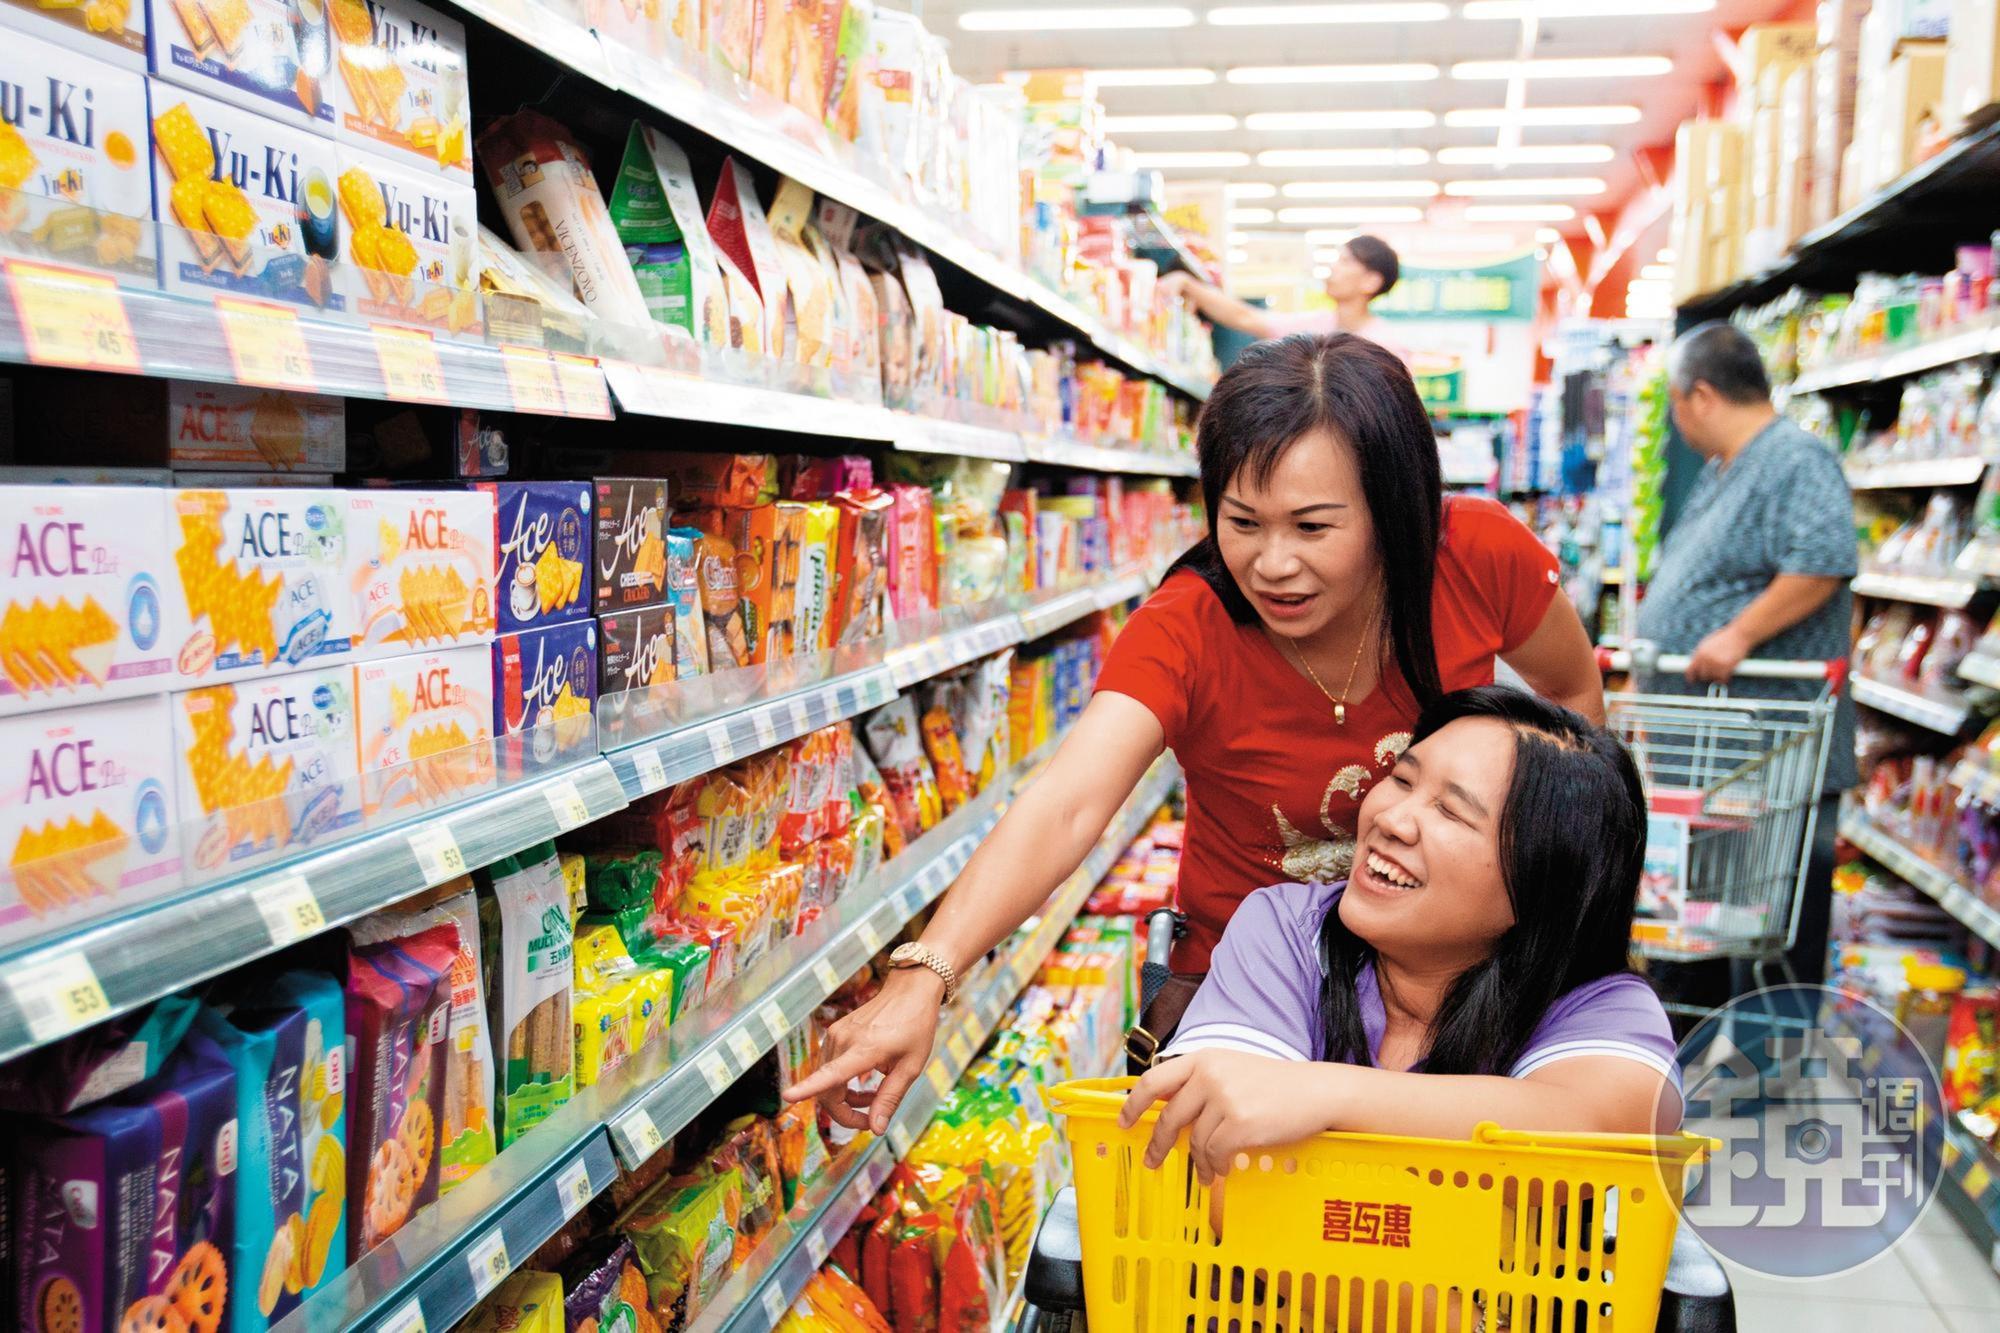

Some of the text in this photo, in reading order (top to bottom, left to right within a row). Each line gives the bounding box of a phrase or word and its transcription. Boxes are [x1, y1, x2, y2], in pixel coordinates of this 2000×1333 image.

[0, 76, 95, 149] u-Ki
[206, 126, 299, 205] Yu-Ki
[378, 181, 449, 245] Yu-Ki
[419, 259, 444, 282] Yu-Ki
[554, 219, 598, 303] VICENZOVO
[178, 402, 229, 443] ACE
[11, 521, 89, 578] ACE
[239, 511, 292, 559] ACE
[406, 509, 449, 551] ACE
[493, 490, 555, 588] Ace
[601, 484, 658, 581] Ace
[289, 579, 315, 604] ACE
[368, 582, 391, 603] ACE
[505, 636, 569, 738] Ace
[611, 615, 667, 714] Ace
[414, 668, 451, 713] ACE
[249, 697, 300, 748] ACE
[23, 739, 98, 805] ACE
[301, 758, 324, 784] ACE
[382, 748, 401, 768] ACE
[443, 847, 461, 869] 53
[297, 903, 319, 927] 53
[71, 986, 101, 1014] 53
[330, 1052, 340, 1088] ORI
[389, 1019, 413, 1128] NATA
[221, 1129, 231, 1168] ORI
[276, 1064, 300, 1201] NATA
[578, 1178, 589, 1199] 99
[149, 1146, 182, 1284] NATA
[1323, 1199, 1412, 1248] 喜互惠
[492, 1251, 506, 1275] 99
